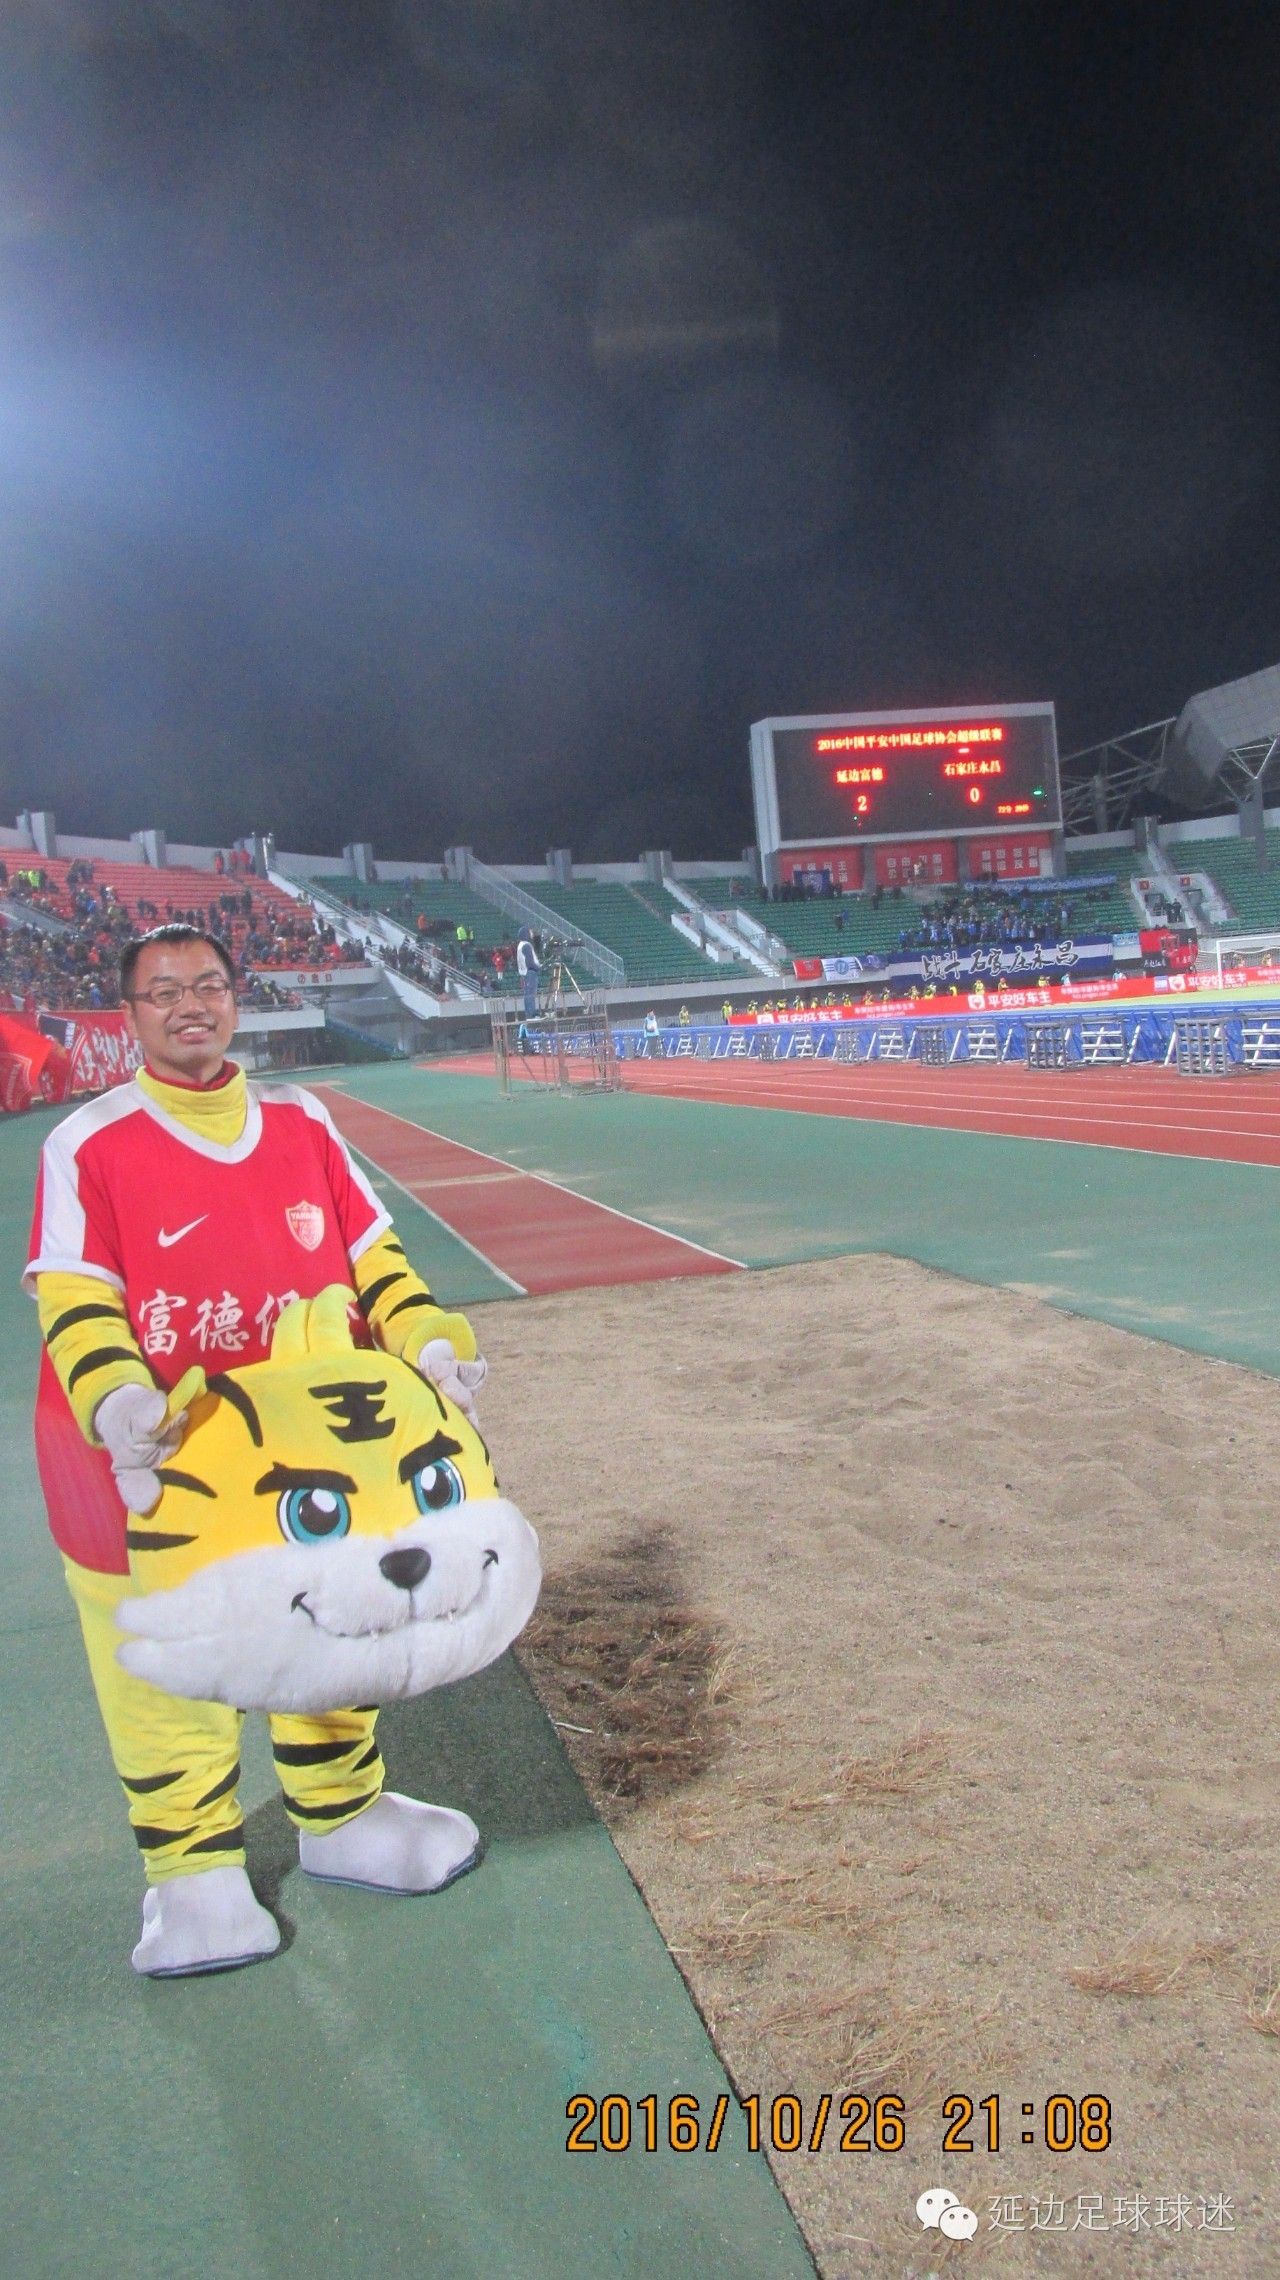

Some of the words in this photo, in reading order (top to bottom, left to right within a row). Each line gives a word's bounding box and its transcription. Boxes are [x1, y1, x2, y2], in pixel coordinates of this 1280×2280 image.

[817, 727, 1003, 751] 2016中国平安中国足球协会超级联赛
[836, 766, 884, 783] 延边富德
[944, 760, 1001, 776] 石家庄永昌
[857, 795, 868, 811] 2
[969, 787, 980, 803] 0
[987, 991, 1052, 1007] 平安好车主
[307, 1379, 396, 1444] 王
